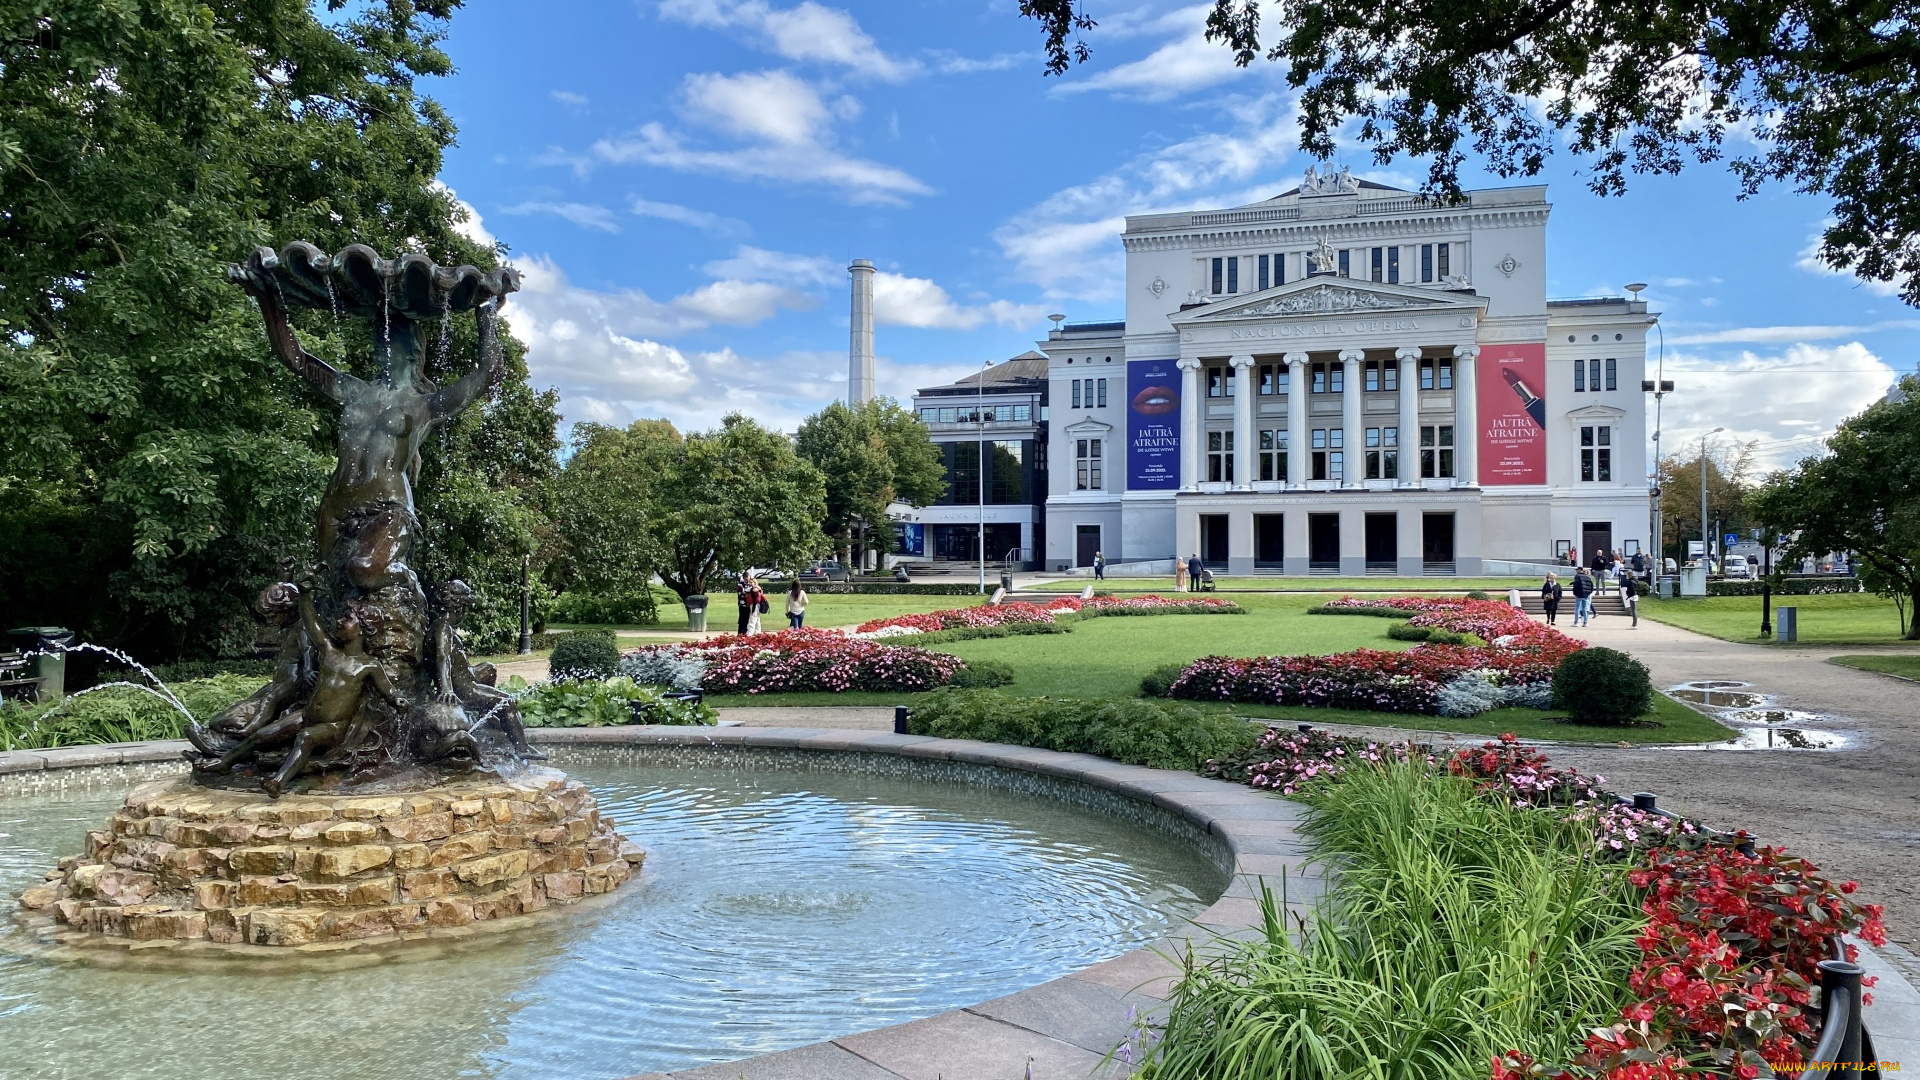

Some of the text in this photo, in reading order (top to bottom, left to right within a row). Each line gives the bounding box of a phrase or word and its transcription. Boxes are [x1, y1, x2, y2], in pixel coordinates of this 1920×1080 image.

[1355, 319, 1420, 333] OPERA
[1492, 416, 1532, 428] JAUTRĀ
[1138, 427, 1173, 438] JAUTRĀ
[1485, 428, 1538, 438] ATRAITNE
[1133, 437, 1179, 447] ATRAITNE
